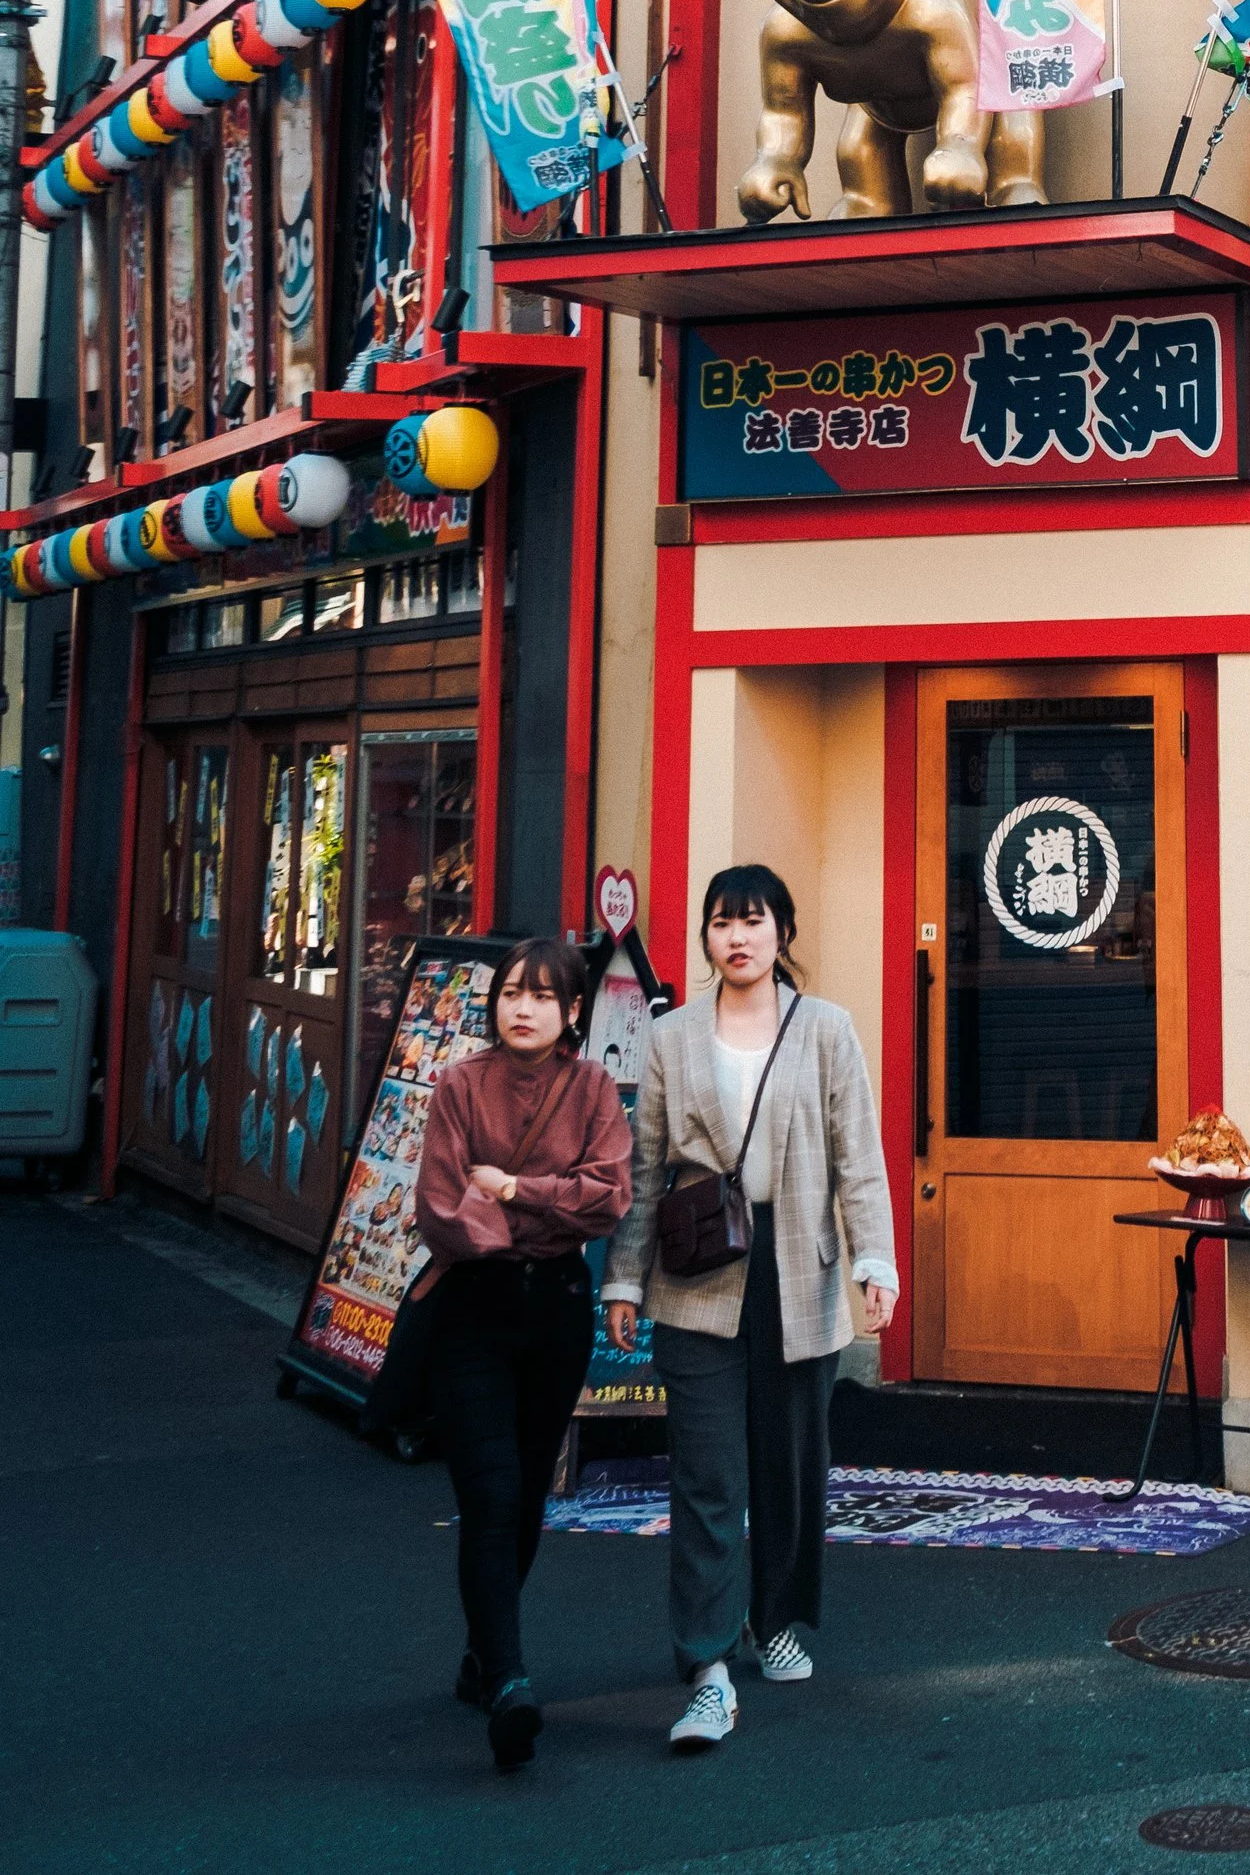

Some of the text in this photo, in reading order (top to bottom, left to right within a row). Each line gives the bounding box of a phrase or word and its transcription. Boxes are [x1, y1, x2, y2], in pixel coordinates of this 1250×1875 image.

[700, 351, 956, 409] 日本一の串かつ
[963, 312, 1222, 466] 横綱
[743, 405, 910, 455] 法善寺店
[1026, 826, 1079, 918] 横綱
